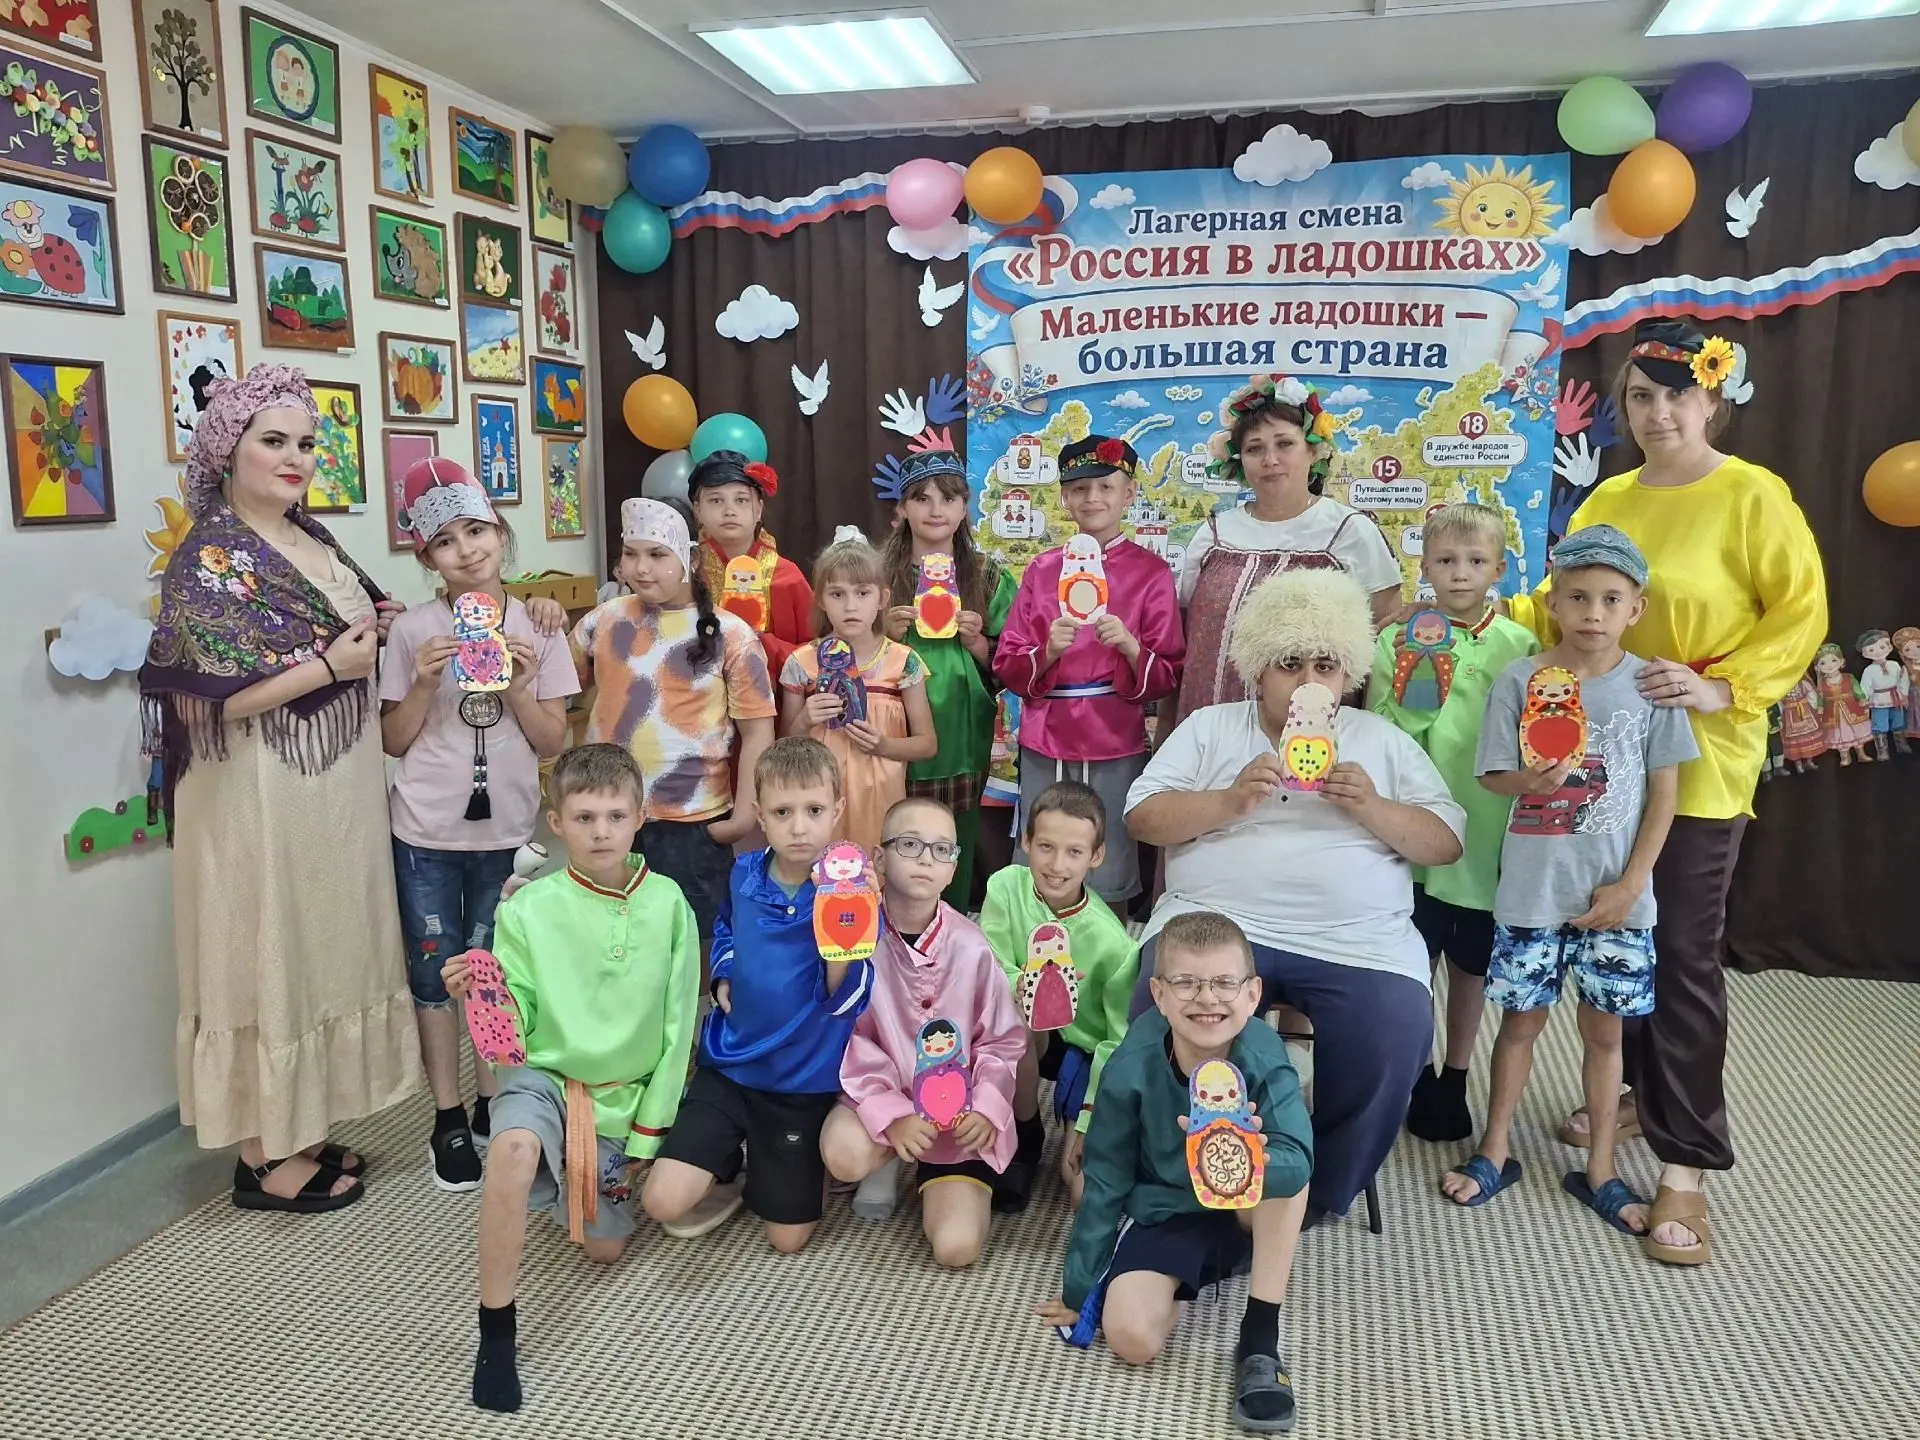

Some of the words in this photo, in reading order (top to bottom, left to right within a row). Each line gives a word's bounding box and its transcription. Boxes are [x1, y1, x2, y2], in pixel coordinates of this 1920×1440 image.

[1128, 207, 1288, 239] Лагерная
[1298, 202, 1403, 231] смена
[1003, 233, 1211, 286] «Россия
[1226, 247, 1253, 275] в
[1267, 236, 1542, 282] ладошках»
[1040, 301, 1260, 342] Маленькие
[1278, 299, 1444, 330] ладошки
[1078, 335, 1279, 375] большая
[1291, 336, 1449, 374] страна
[1462, 415, 1484, 434] 18
[1426, 442, 1433, 450] В
[1435, 442, 1470, 452] дружбе
[1472, 442, 1509, 451] народов
[1433, 453, 1475, 462] единство
[1477, 452, 1510, 461] России
[1375, 460, 1397, 477] 15
[1355, 484, 1410, 494] Путешествие
[1353, 494, 1393, 505] Золотому
[1394, 496, 1424, 506] кольцу
